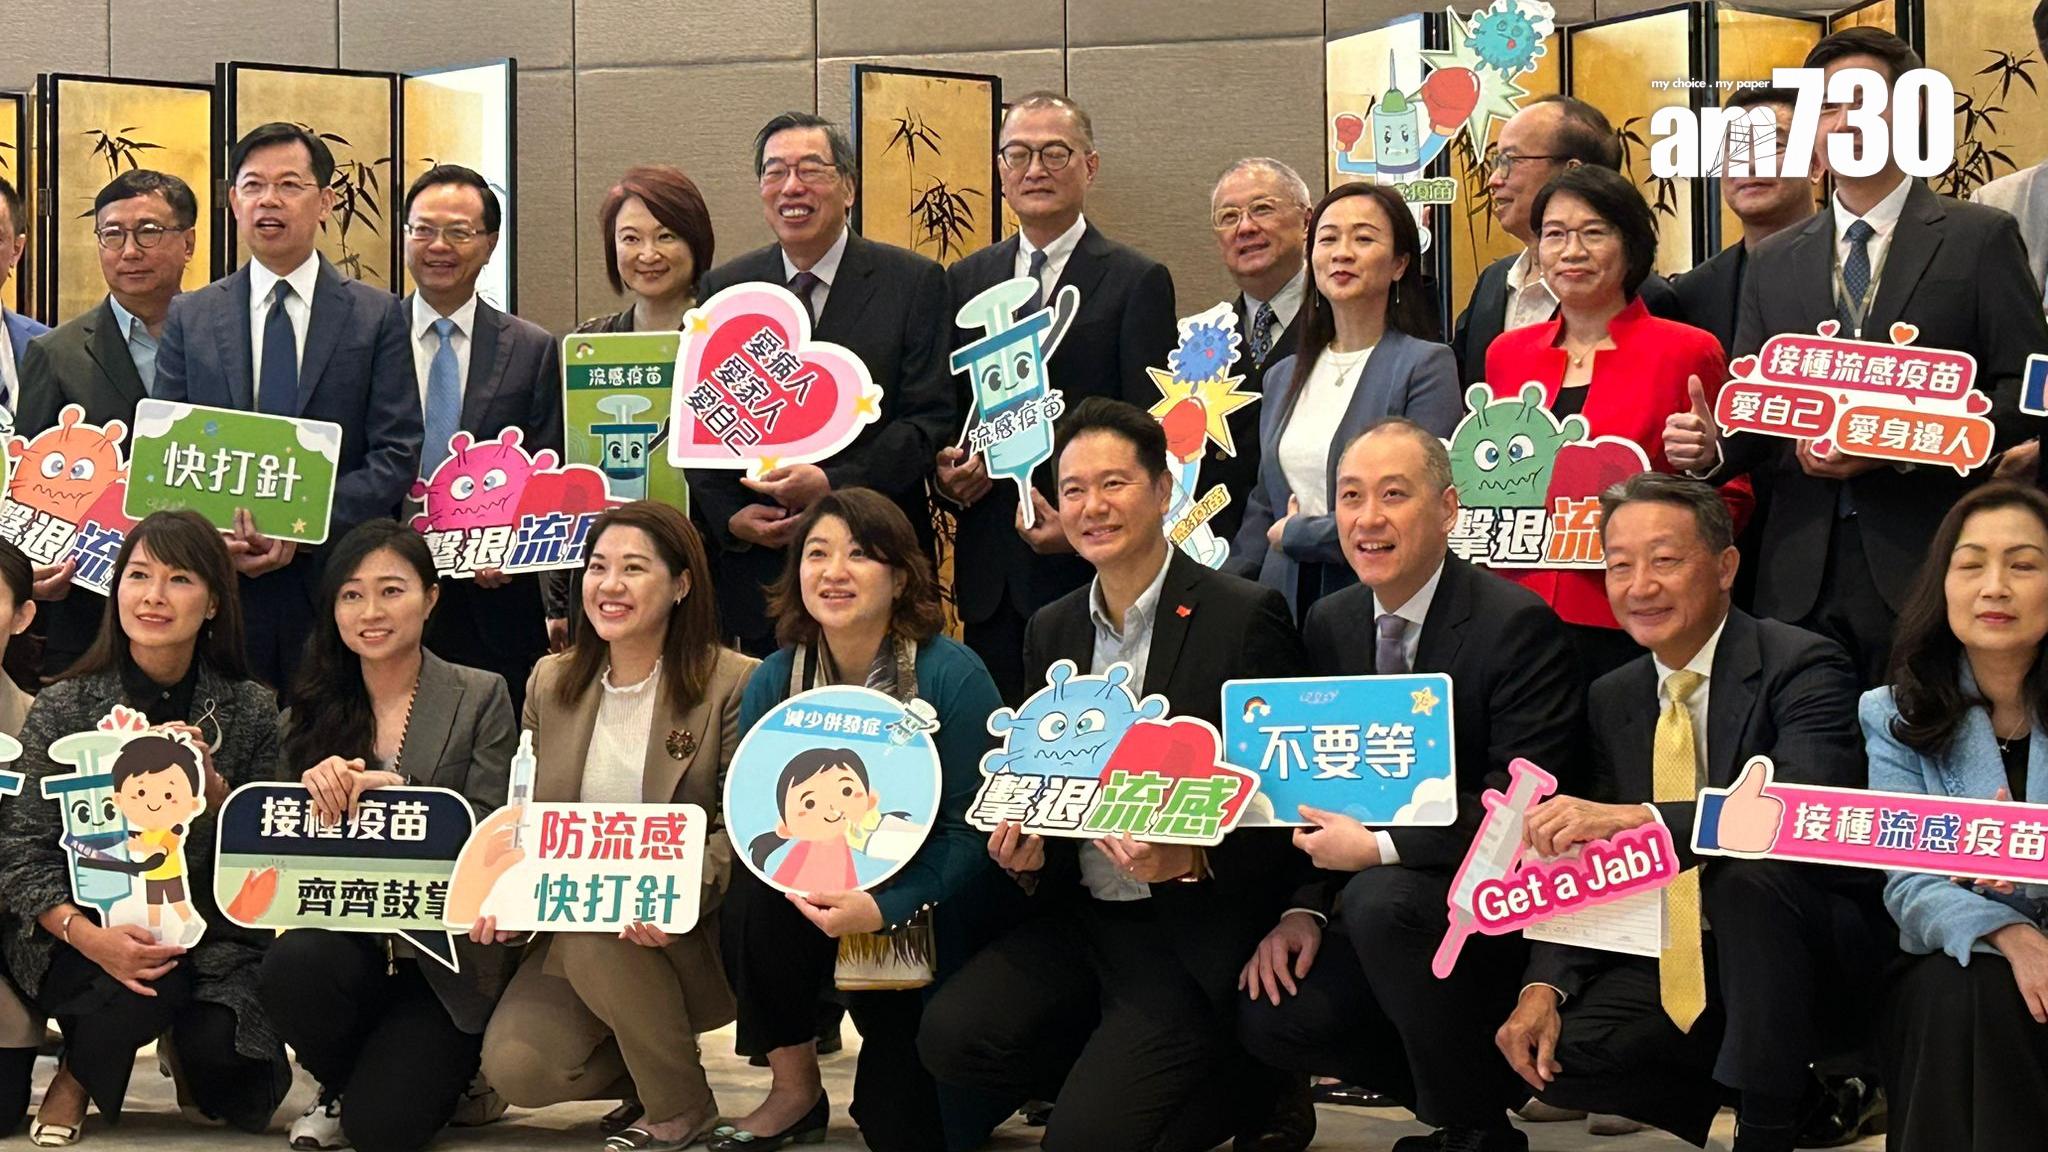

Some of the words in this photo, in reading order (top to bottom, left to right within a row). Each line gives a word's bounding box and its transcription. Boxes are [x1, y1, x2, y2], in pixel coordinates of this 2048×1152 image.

[588, 366, 662, 386] 流感疫苗
[712, 354, 787, 433] 愛家人
[744, 326, 817, 404] 愛病人
[1769, 344, 1964, 393] 接種流感疫苗
[684, 380, 761, 457] 愛自己
[970, 391, 1061, 452] 流感疫苗
[1730, 389, 1825, 430] 愛自己
[1848, 413, 1976, 460] 愛身邊人
[163, 440, 302, 503] 快打針
[0, 496, 124, 587] 擊退流
[784, 707, 882, 736] 減少併發症
[1258, 721, 1418, 781] 不要等
[260, 796, 430, 841] 接種疫苗
[974, 770, 1240, 837] 擊退流感
[1792, 802, 2048, 861] 接種流感疫苗
[538, 810, 688, 861] 防流感
[533, 872, 681, 925] 快打針
[1478, 874, 1547, 921] Get
[1554, 872, 1579, 900] a
[1586, 837, 1664, 891] Jab!
